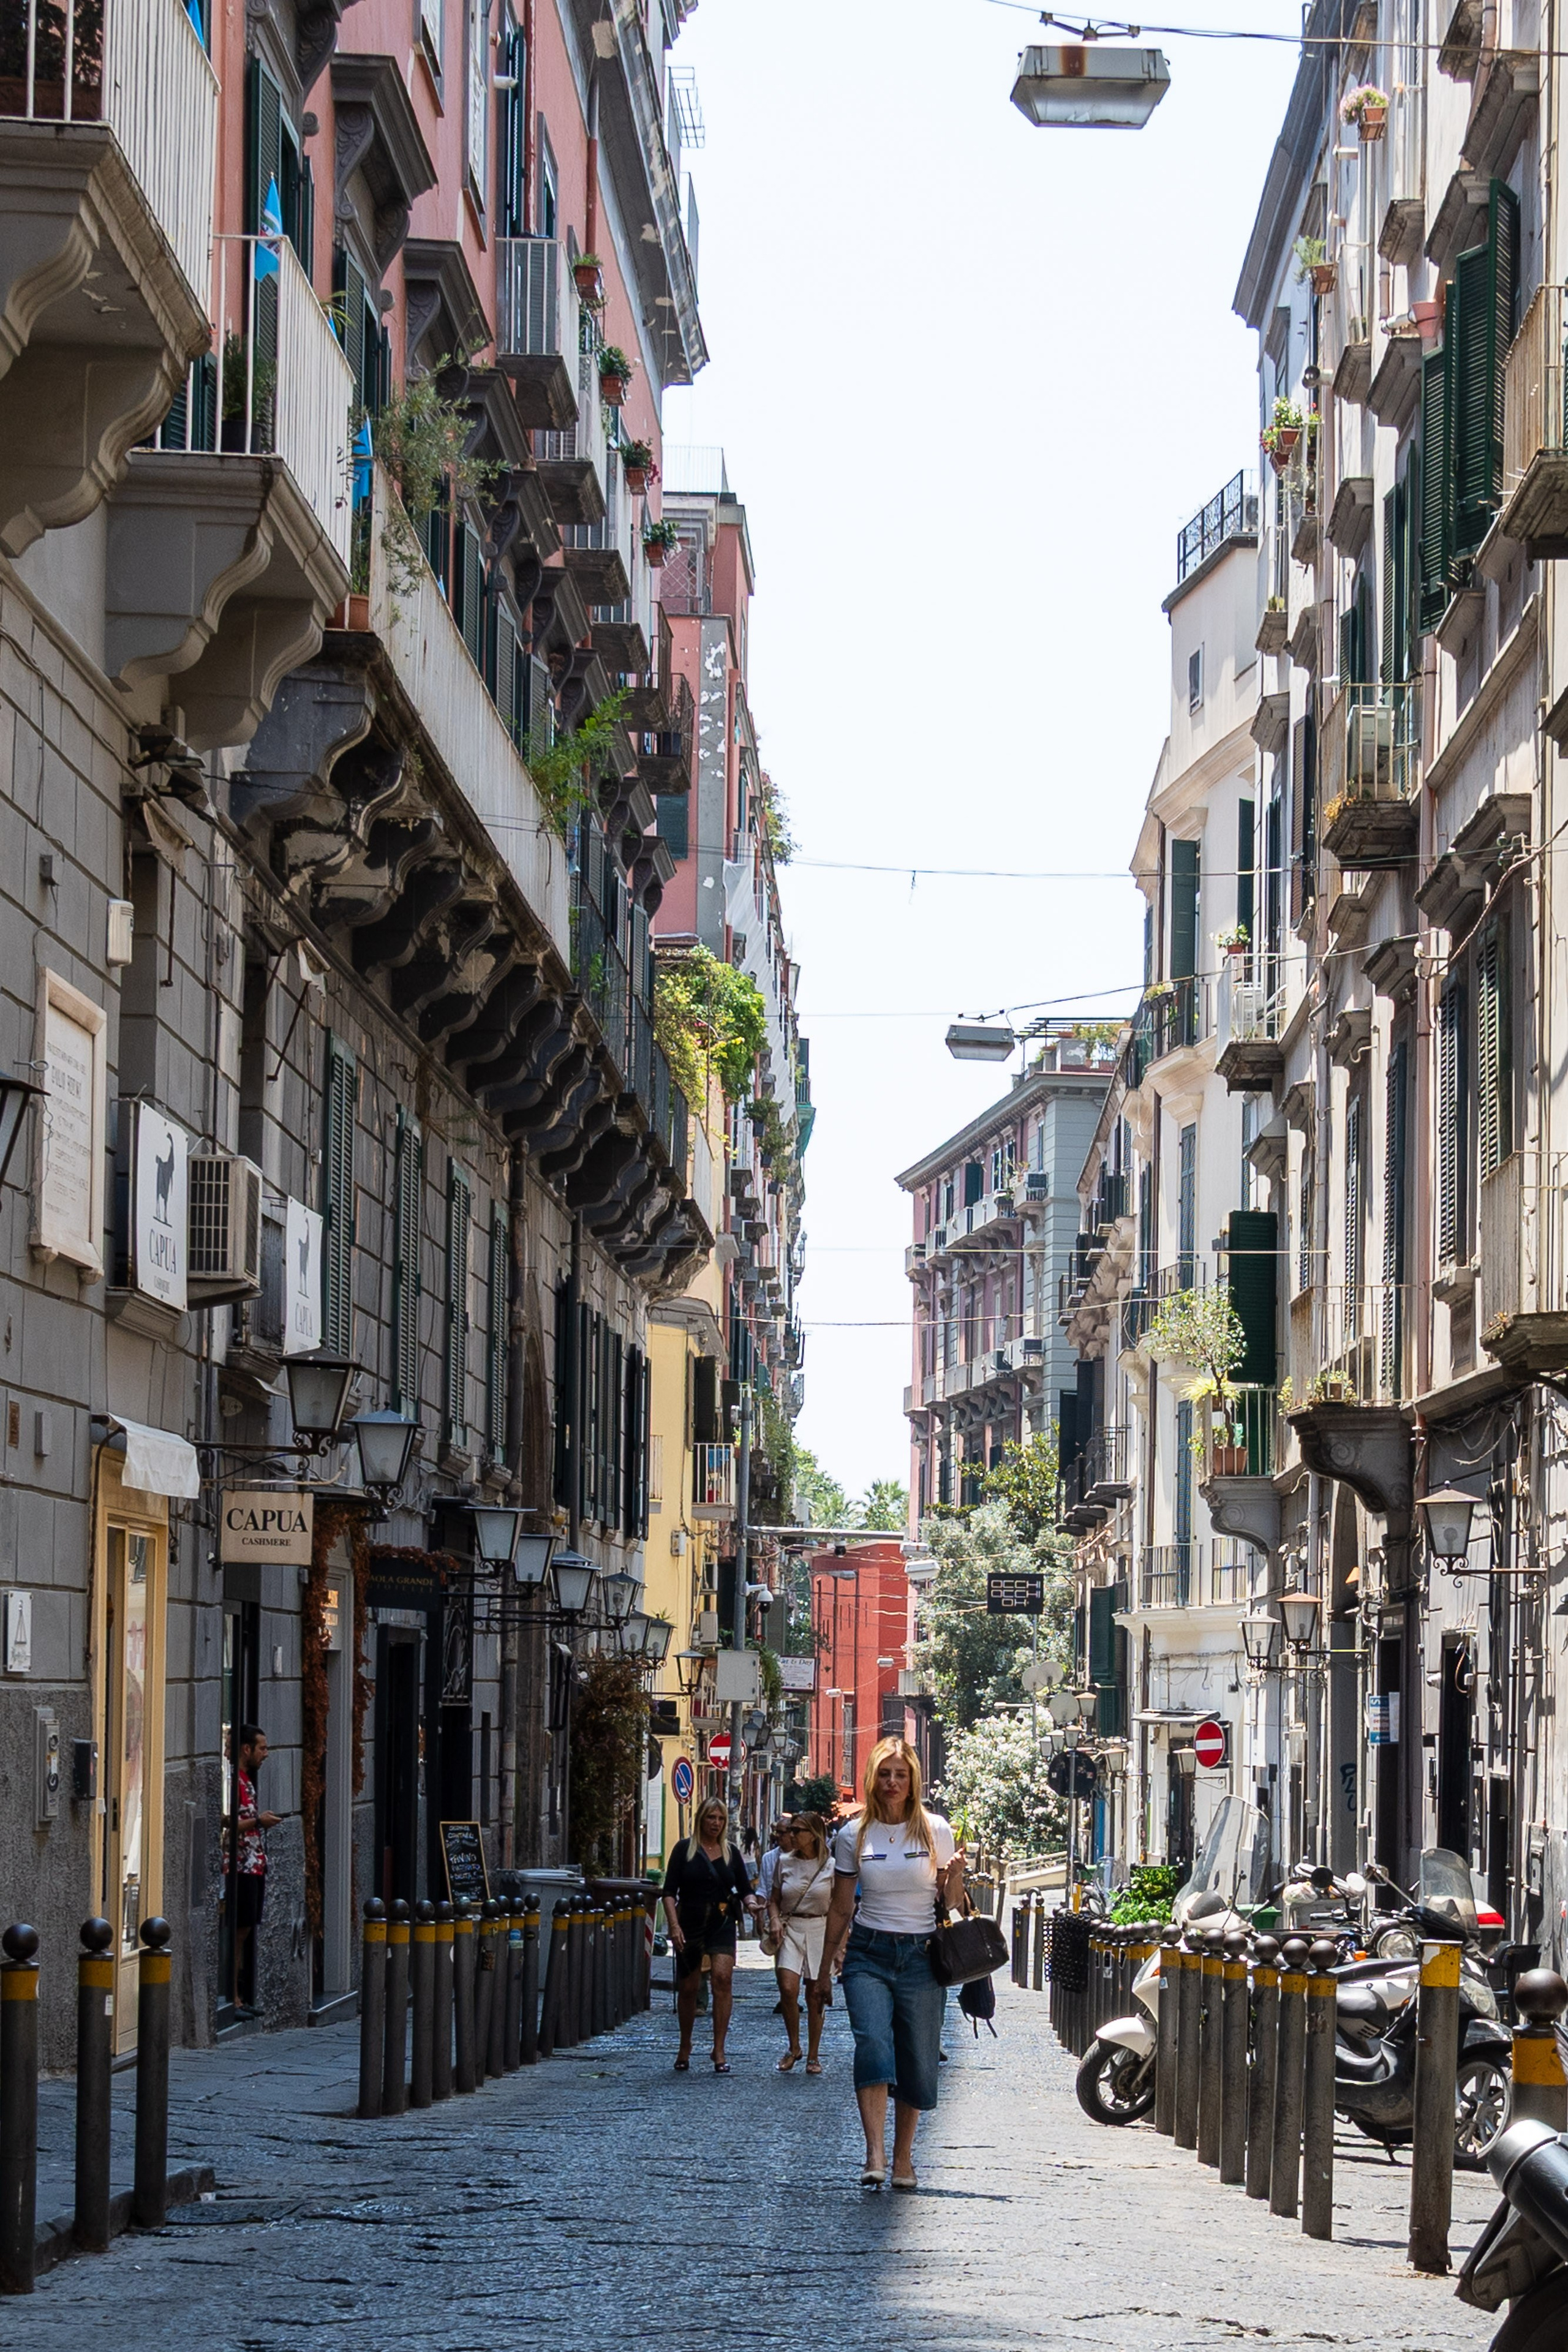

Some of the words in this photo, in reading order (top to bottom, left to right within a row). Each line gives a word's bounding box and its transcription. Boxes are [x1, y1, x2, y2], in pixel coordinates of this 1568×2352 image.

[149, 1229, 176, 1274] CAPUA
[226, 1507, 308, 1532] CAPUA
[241, 1537, 292, 1547] CASHMERE
[369, 1574, 394, 1583] AOLA
[396, 1576, 435, 1586] GRANDE
[990, 1580, 1041, 1588] OCCHI
[990, 1589, 1041, 1598] OCCHI
